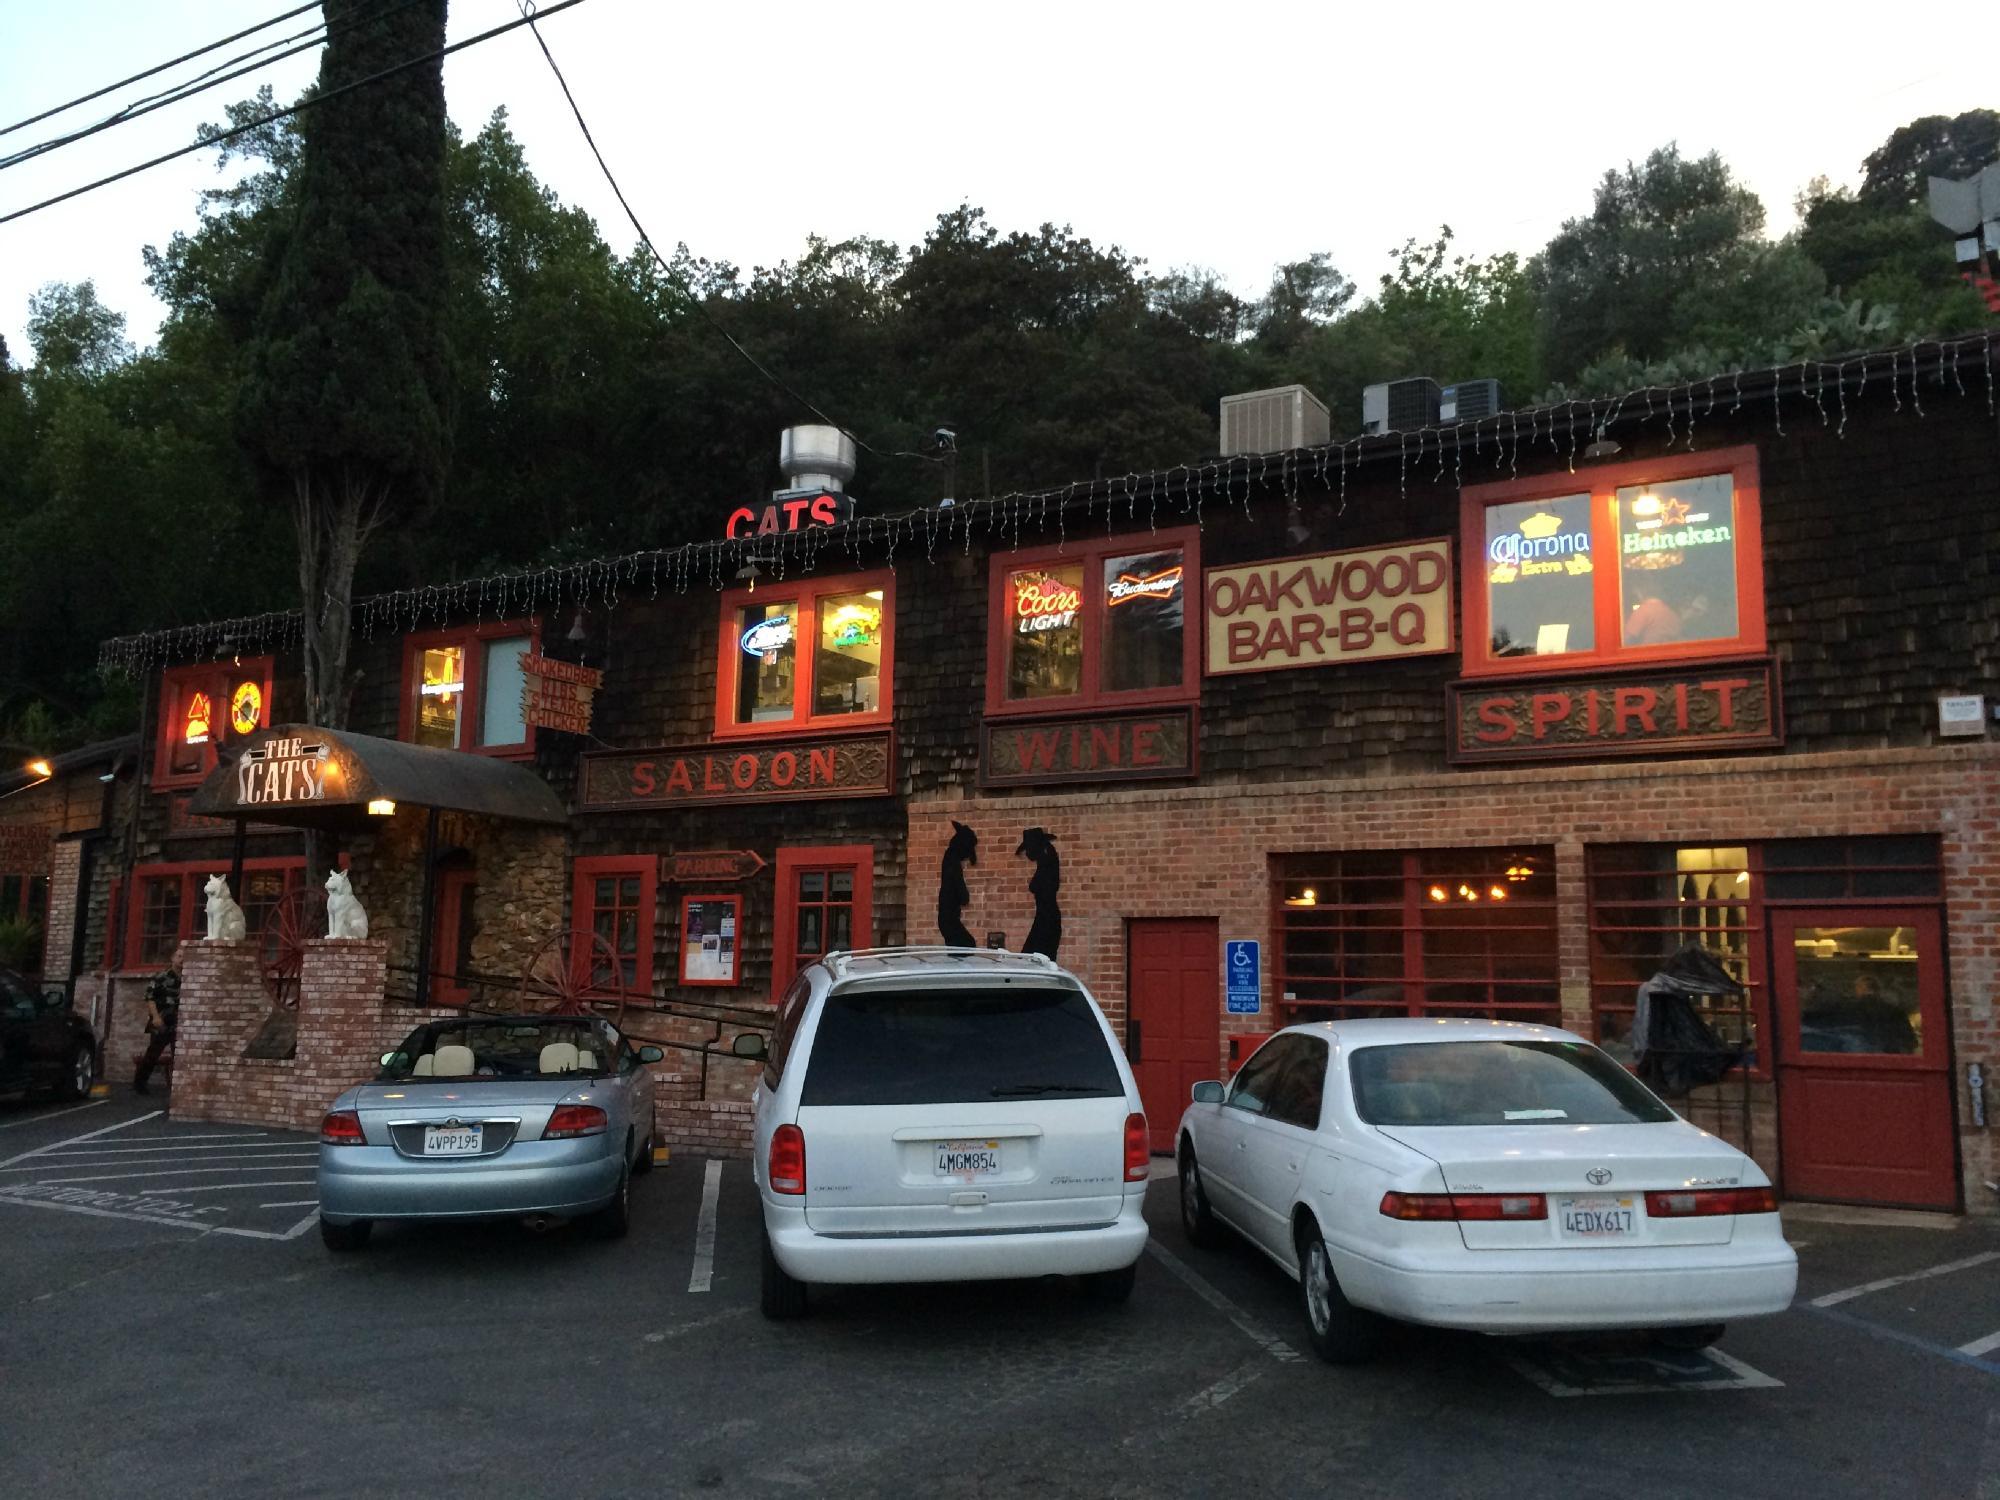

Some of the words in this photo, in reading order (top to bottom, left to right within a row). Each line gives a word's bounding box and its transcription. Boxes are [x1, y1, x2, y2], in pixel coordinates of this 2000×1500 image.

[727, 496, 836, 540] CATS
[1490, 532, 1590, 564] Corona
[1624, 526, 1730, 553] Heineken
[1109, 578, 1179, 598] Budweiser
[1208, 551, 1446, 617] OAKWOOD
[1018, 585, 1080, 616] Coors
[1020, 611, 1075, 633] LIGHT
[1228, 602, 1426, 664] BAR-B-Q
[541, 677, 577, 701] RIBS
[531, 692, 585, 716] STEAKS
[1476, 679, 1748, 742] SPIRIT
[528, 709, 586, 733] CHICKEN
[265, 738, 302, 759] THE
[1015, 723, 1163, 774] WINE
[247, 759, 317, 803] CATS
[630, 748, 834, 796] SALOON
[428, 1135, 479, 1150] 4VPP195
[939, 1153, 996, 1172] 4MGM854
[1566, 1211, 1631, 1232] 4EDX617
